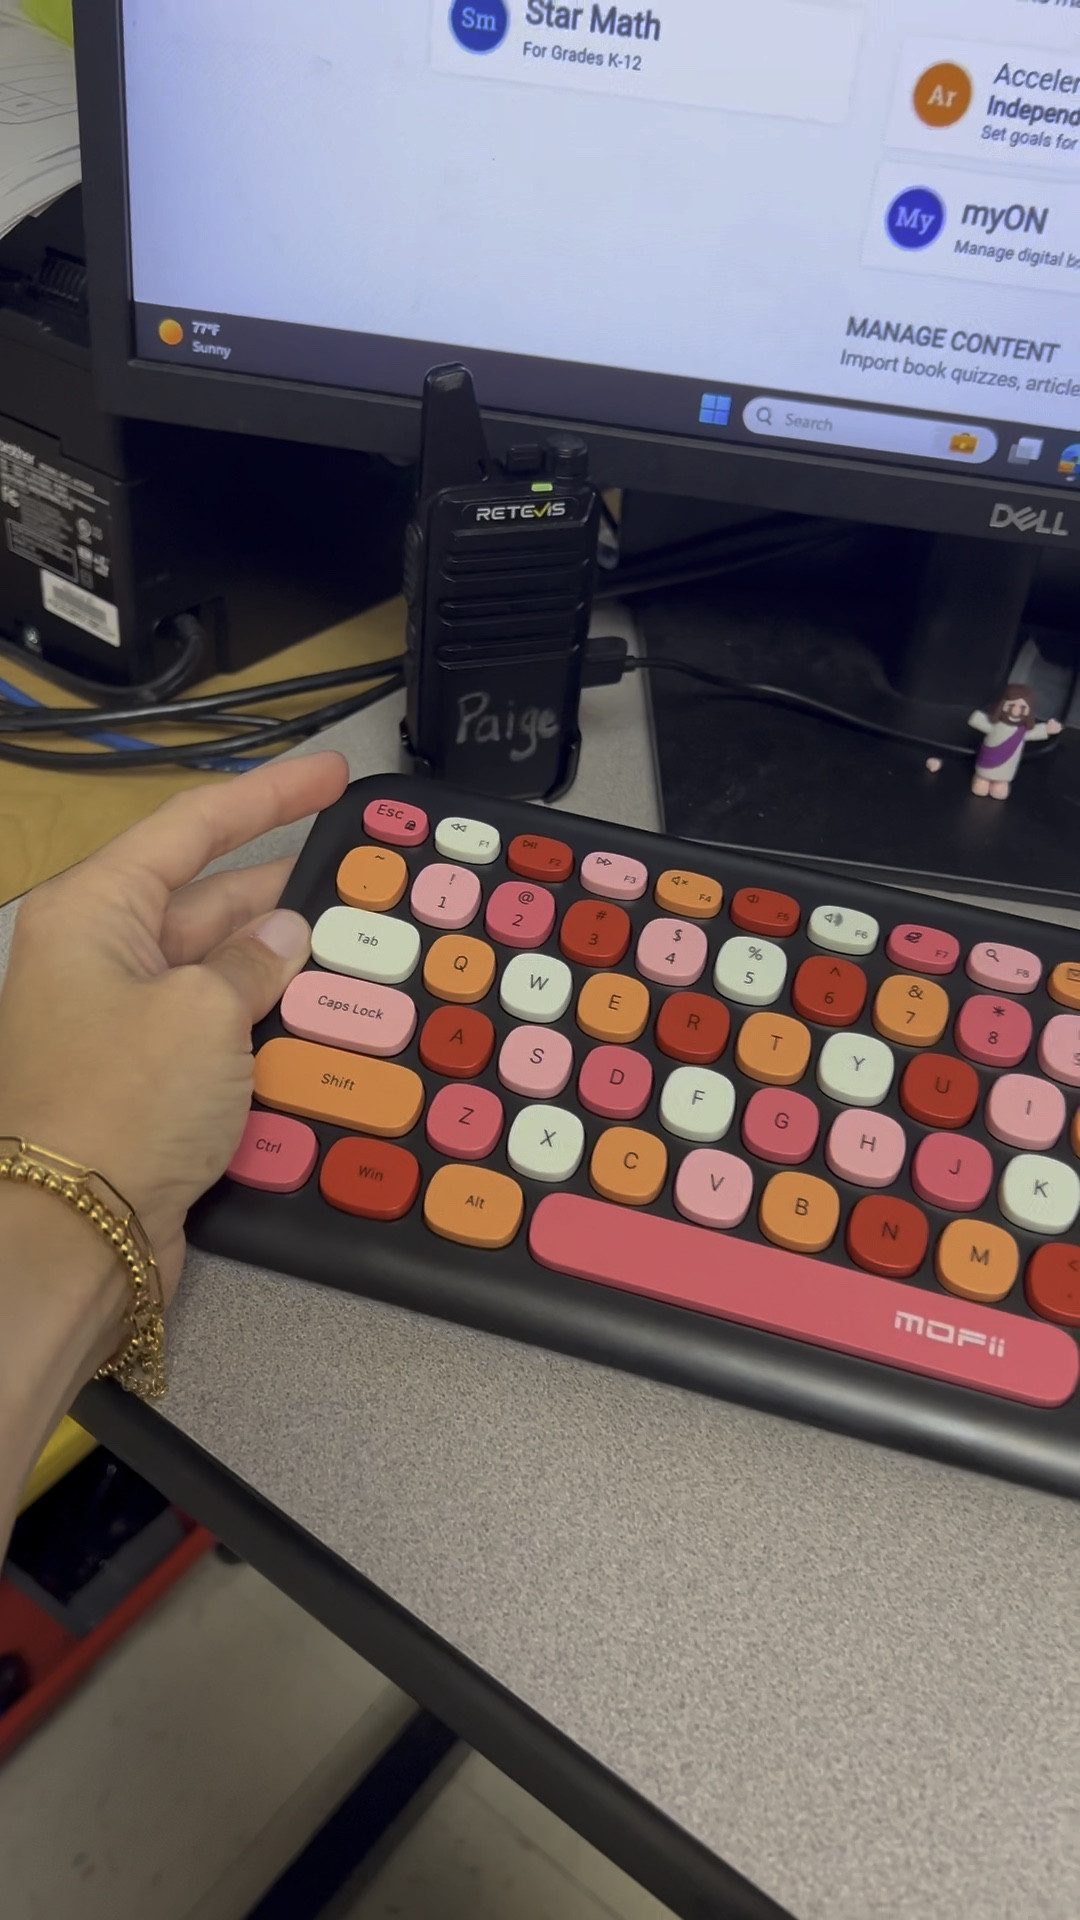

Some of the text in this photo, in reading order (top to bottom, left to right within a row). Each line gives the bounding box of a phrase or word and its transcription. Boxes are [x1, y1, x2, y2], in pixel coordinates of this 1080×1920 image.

[461, 6, 497, 32] Sm
[525, 0, 661, 42] Star Math
[522, 41, 642, 71] For Grades K-12
[926, 84, 957, 108] Ar
[981, 125, 1079, 150] Set goals for
[895, 206, 935, 236] My
[961, 204, 1049, 235] myON
[953, 239, 1015, 263] Manage
[1017, 247, 1065, 268] digital
[845, 315, 1062, 364] MANAGE CONTENT
[192, 340, 232, 360] Sunny
[840, 349, 900, 373] Import
[902, 357, 947, 379] book
[950, 366, 1020, 391] quizzes,
[784, 412, 834, 432] Search
[476, 502, 566, 522] RETEVIS
[989, 502, 1069, 536] DELL
[456, 690, 560, 763] Paige
[478, 840, 490, 849] F1
[624, 875, 636, 885] F3
[437, 896, 447, 909] 1
[518, 890, 534, 904] @
[699, 893, 712, 903] F4
[512, 914, 524, 927] 2
[596, 911, 607, 920] #
[357, 932, 379, 947] Tab
[588, 933, 598, 945] 3
[673, 929, 683, 942] $
[855, 929, 868, 939] F6
[665, 952, 676, 965] 4
[748, 946, 763, 961] %
[935, 950, 948, 959] F7
[453, 955, 468, 972] Q
[744, 971, 754, 984] 5
[1015, 968, 1030, 978] F8
[529, 974, 549, 991] W
[824, 991, 835, 1004] 6
[908, 985, 923, 1000] &
[318, 994, 384, 1020] Caps Lock
[608, 994, 622, 1010] E
[687, 1013, 701, 1030] R
[905, 1011, 916, 1024] 7
[449, 1028, 463, 1044] A
[770, 1034, 783, 1051] T
[988, 1031, 999, 1044] 8
[529, 1048, 545, 1064] S
[852, 1055, 866, 1071] Y
[321, 1073, 355, 1091] Shift
[609, 1068, 624, 1085] D
[935, 1076, 951, 1094] U
[691, 1089, 705, 1105] F
[458, 1107, 475, 1125] Z
[1026, 1100, 1032, 1115] I
[774, 1112, 790, 1129] G
[255, 1138, 281, 1154] Ctrl
[540, 1129, 557, 1147] X
[860, 1134, 876, 1152] H
[623, 1151, 639, 1169] C
[949, 1158, 962, 1175] J
[358, 1165, 384, 1182] Win
[711, 1173, 725, 1191] V
[1033, 1179, 1048, 1198] K
[464, 1195, 485, 1209] Alt
[795, 1197, 809, 1216] B
[882, 1221, 899, 1240] N
[970, 1245, 990, 1266] M
